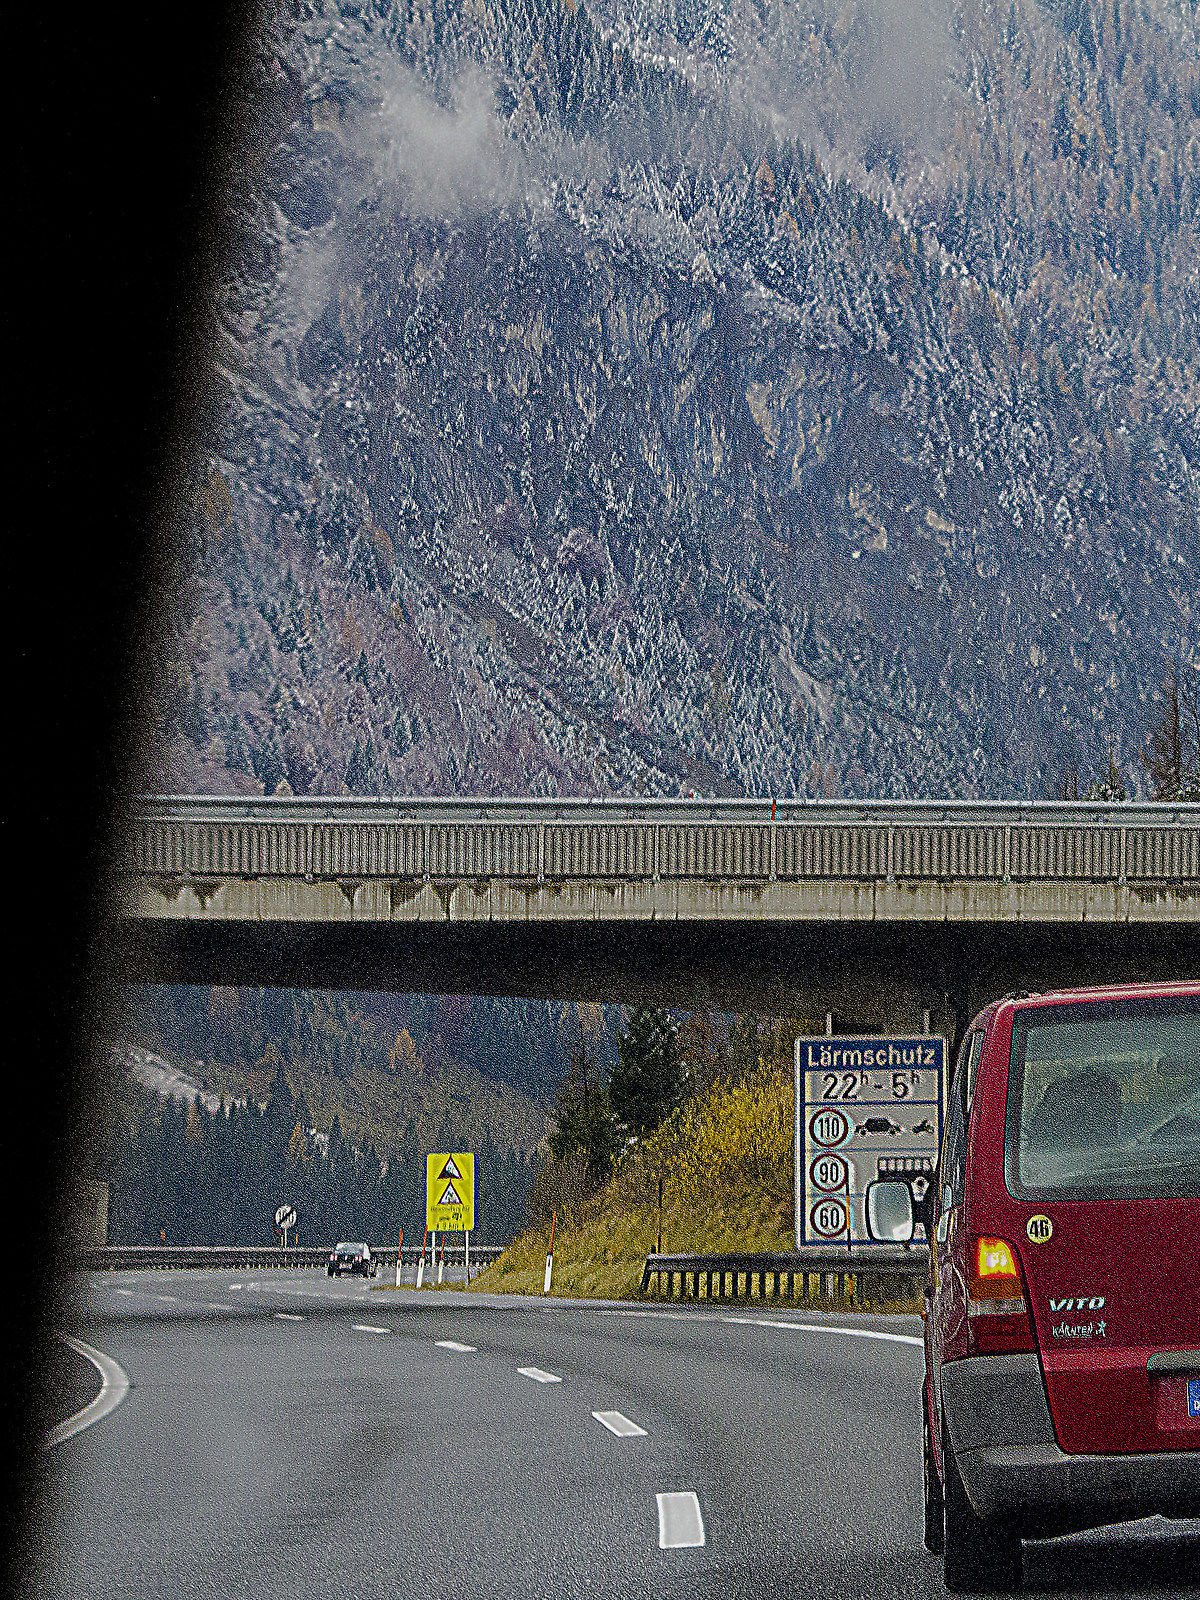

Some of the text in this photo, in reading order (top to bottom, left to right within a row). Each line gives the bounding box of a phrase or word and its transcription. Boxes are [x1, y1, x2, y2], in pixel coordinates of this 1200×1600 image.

[807, 1044, 936, 1068] Lärmschutz
[817, 1116, 840, 1139] 110
[819, 1161, 840, 1184] 90
[819, 1206, 840, 1229] 60
[1029, 1218, 1050, 1239] 46
[1048, 1296, 1106, 1312] VITO
